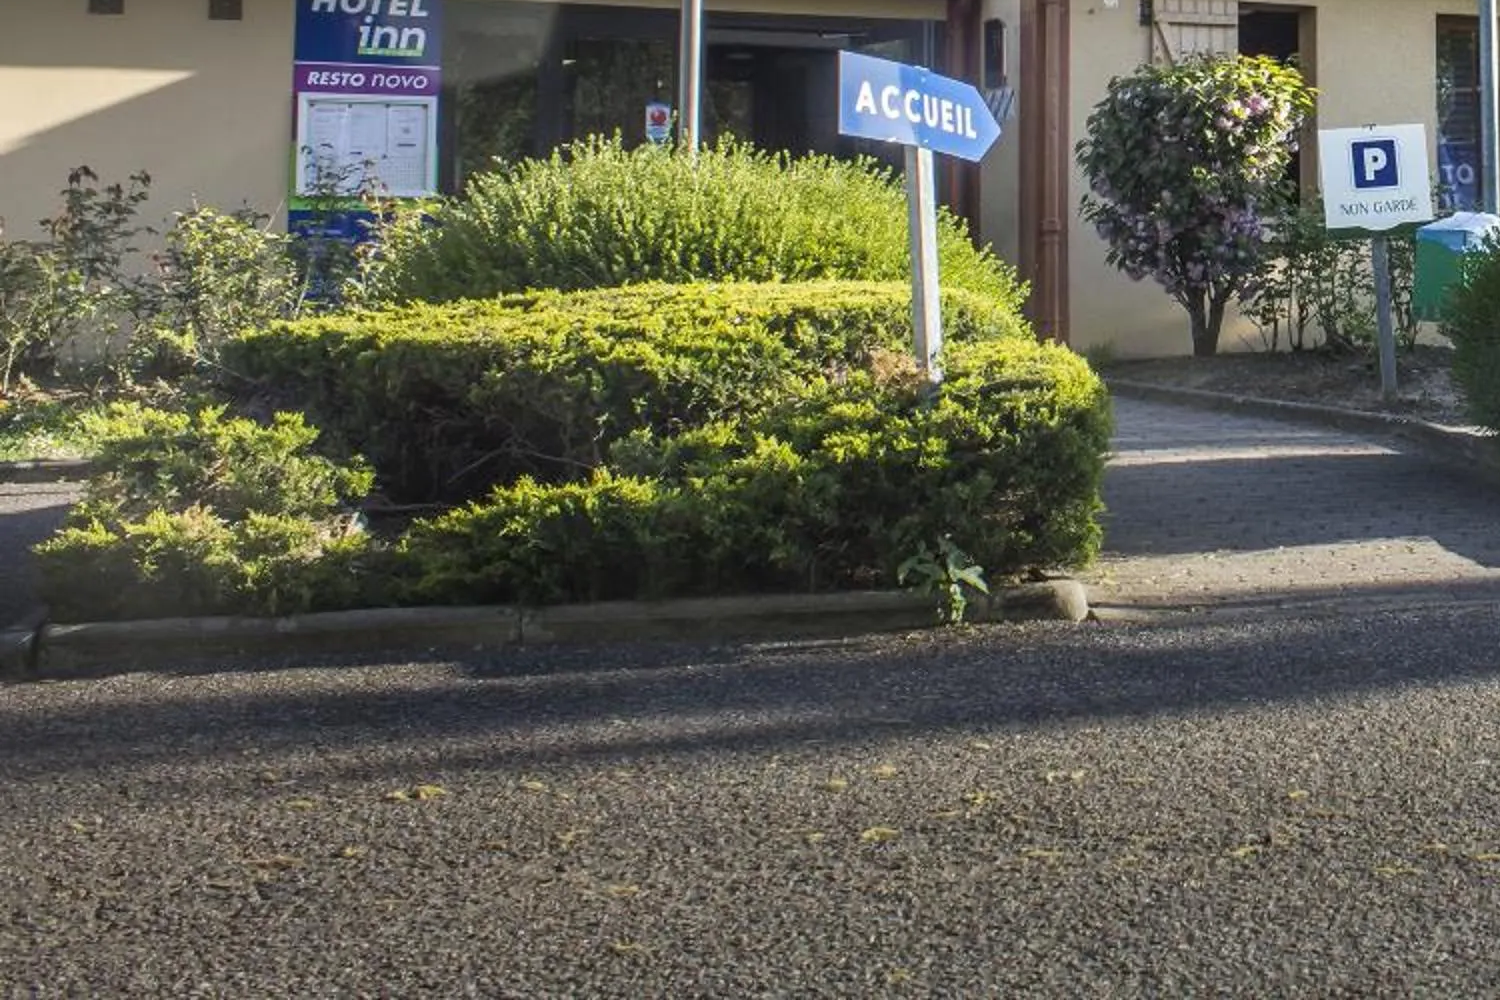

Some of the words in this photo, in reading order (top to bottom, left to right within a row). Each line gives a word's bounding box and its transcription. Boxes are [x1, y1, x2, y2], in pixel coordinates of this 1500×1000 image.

[358, 15, 427, 51] inn
[307, 71, 365, 87] RESTO
[855, 80, 977, 139] ACCUEIL
[1363, 147, 1387, 181] P
[1340, 201, 1369, 216] NON
